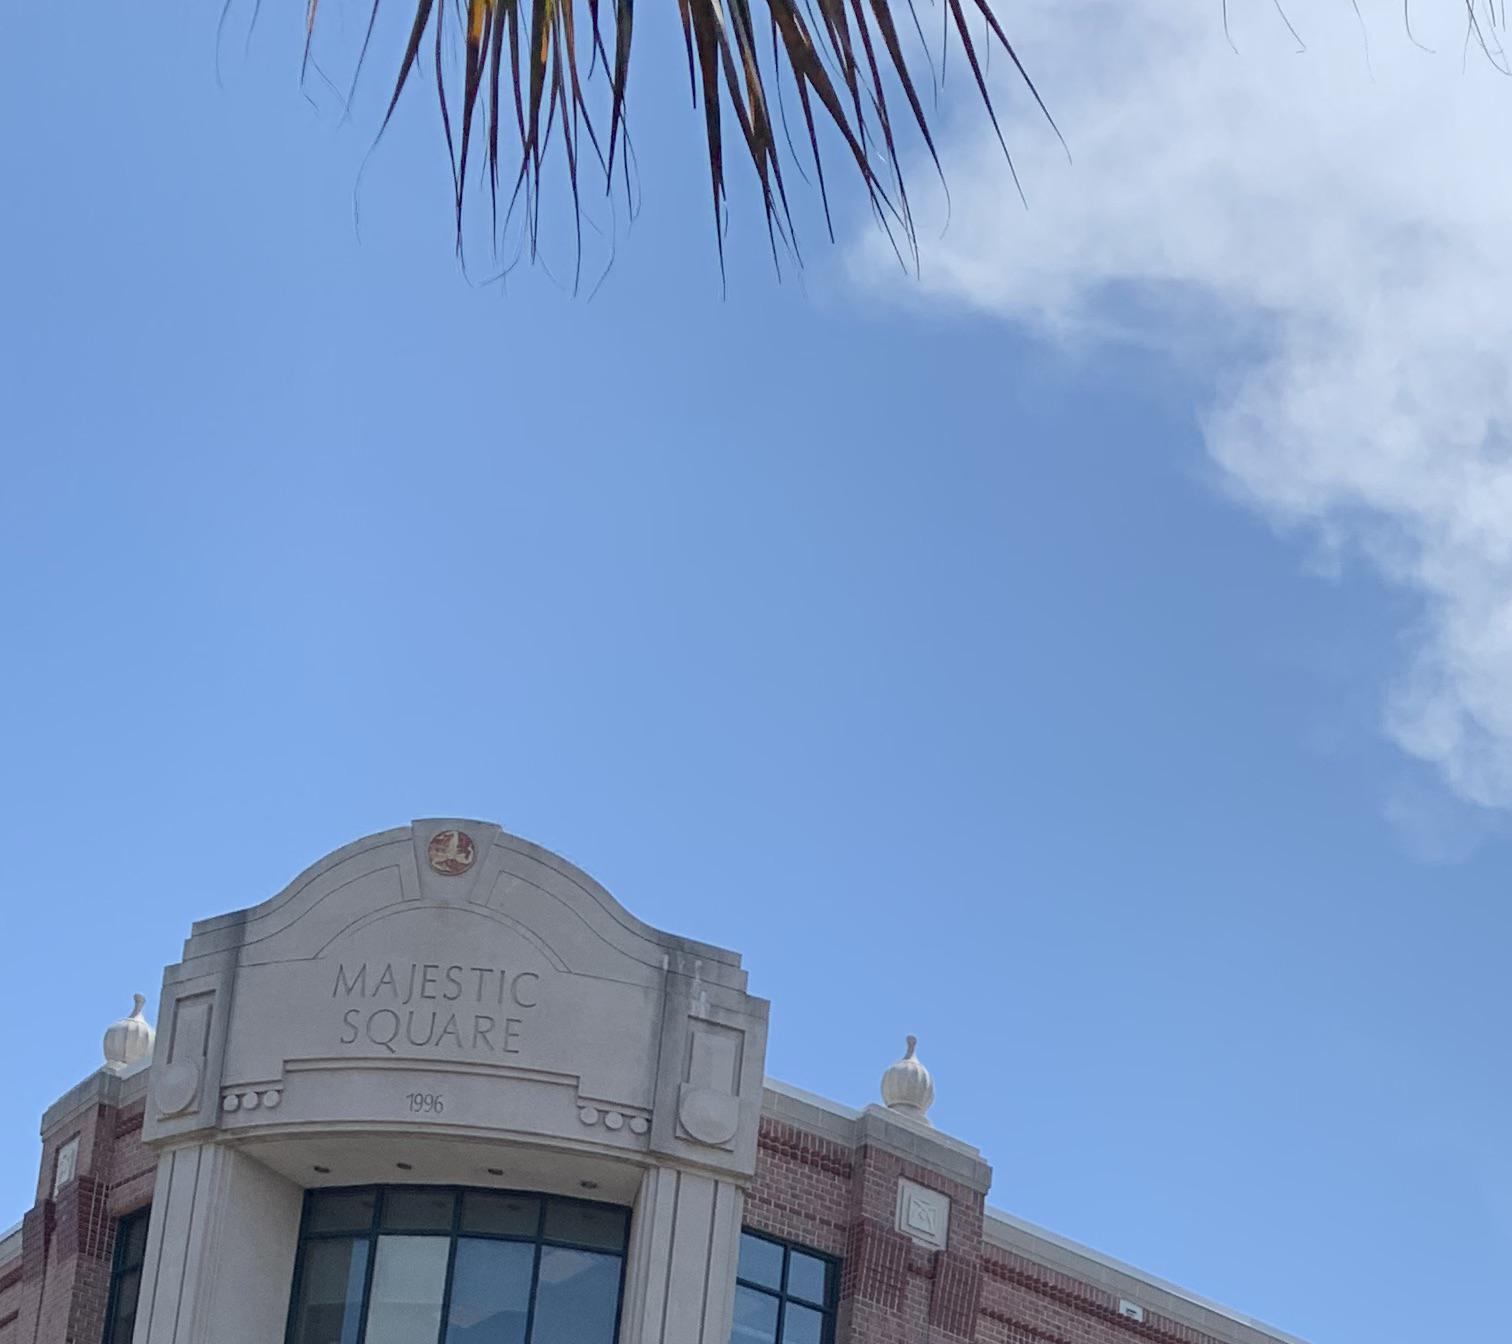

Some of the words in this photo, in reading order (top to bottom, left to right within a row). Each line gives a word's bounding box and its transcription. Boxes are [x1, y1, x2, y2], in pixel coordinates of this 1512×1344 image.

[332, 962, 540, 1008] MAJESTIC
[340, 1009, 523, 1054] SQUARE
[406, 1092, 444, 1114] 1996
